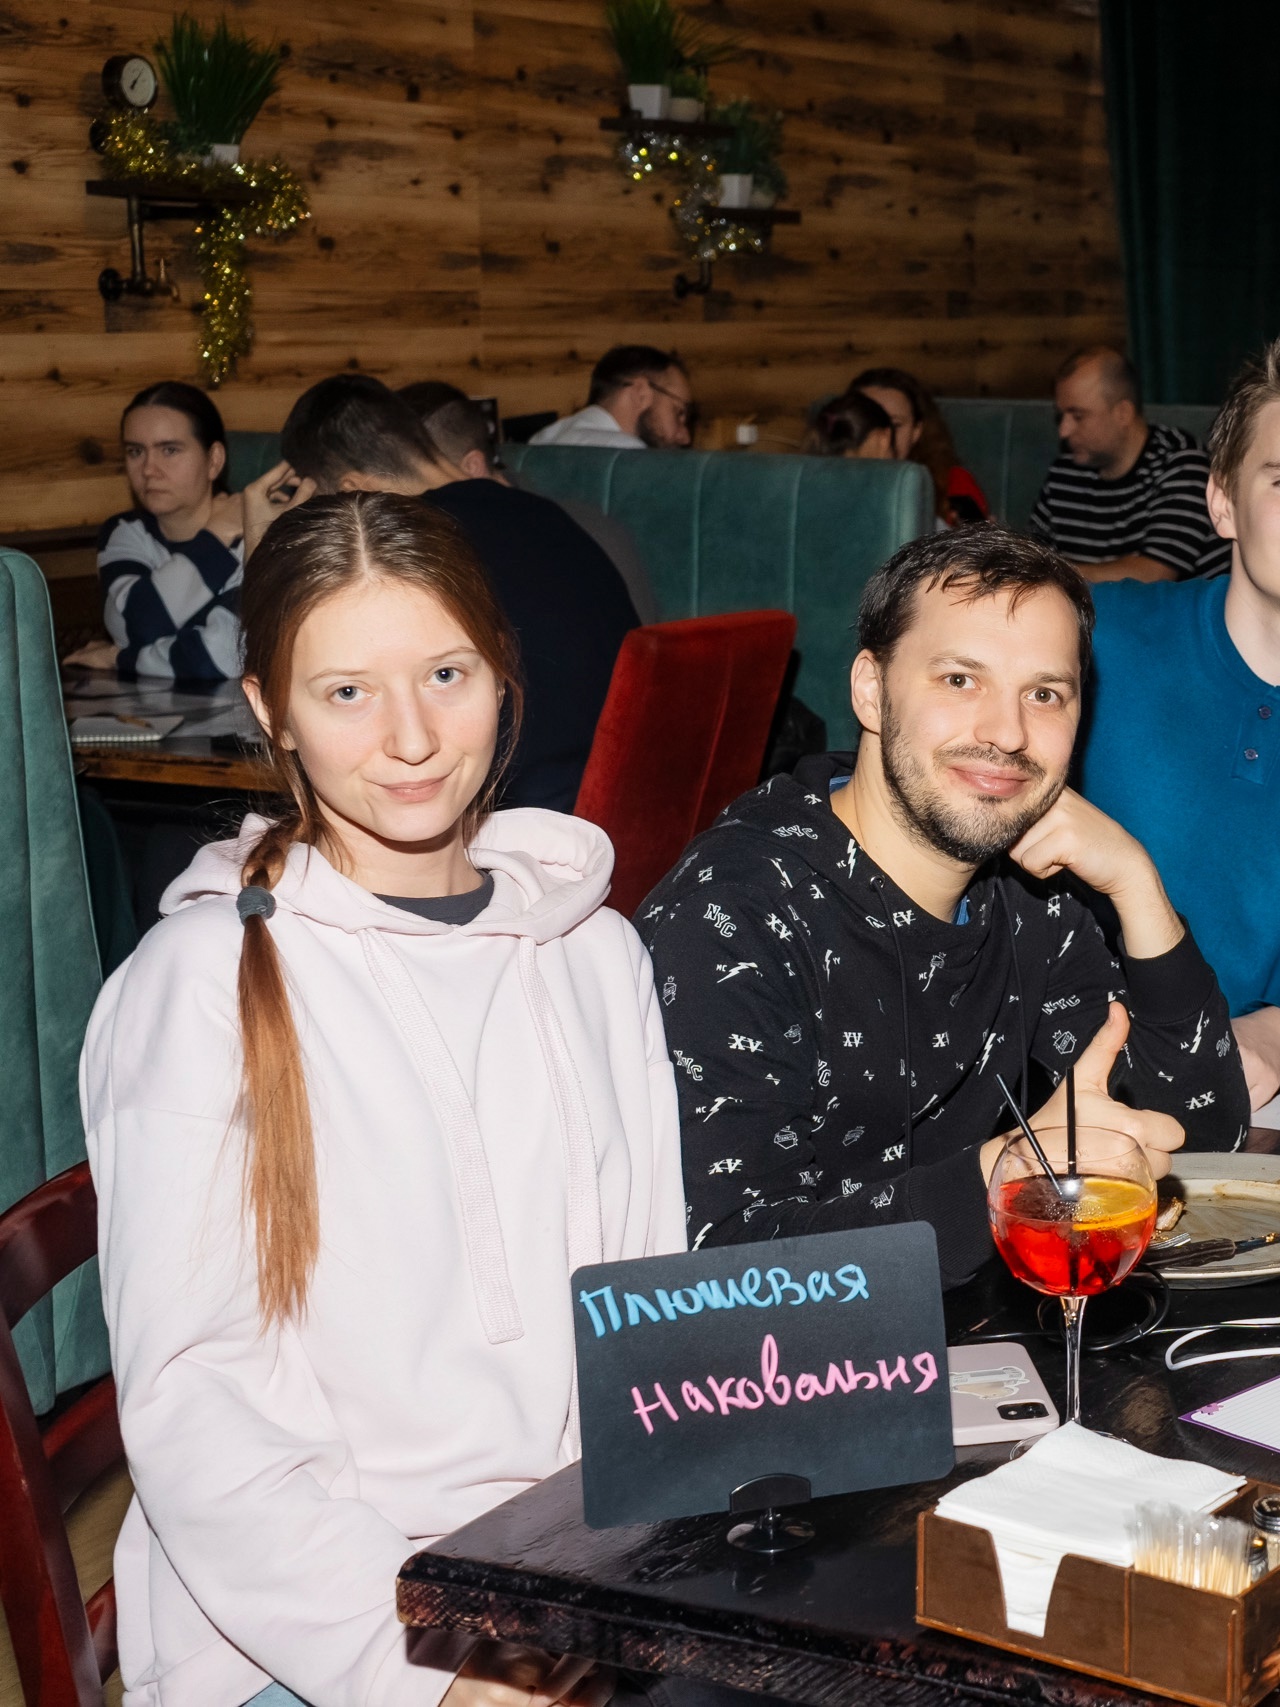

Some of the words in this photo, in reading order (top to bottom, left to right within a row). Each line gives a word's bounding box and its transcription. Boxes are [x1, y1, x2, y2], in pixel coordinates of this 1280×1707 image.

[703, 903, 737, 938] NYC
[765, 913, 794, 942] XV
[728, 1033, 764, 1052] XV
[843, 1031, 864, 1047] XV
[881, 1144, 905, 1162] XV
[708, 1158, 743, 1175] XV
[579, 1263, 870, 1338] Плюшевая
[631, 1333, 939, 1436] Наковальня
